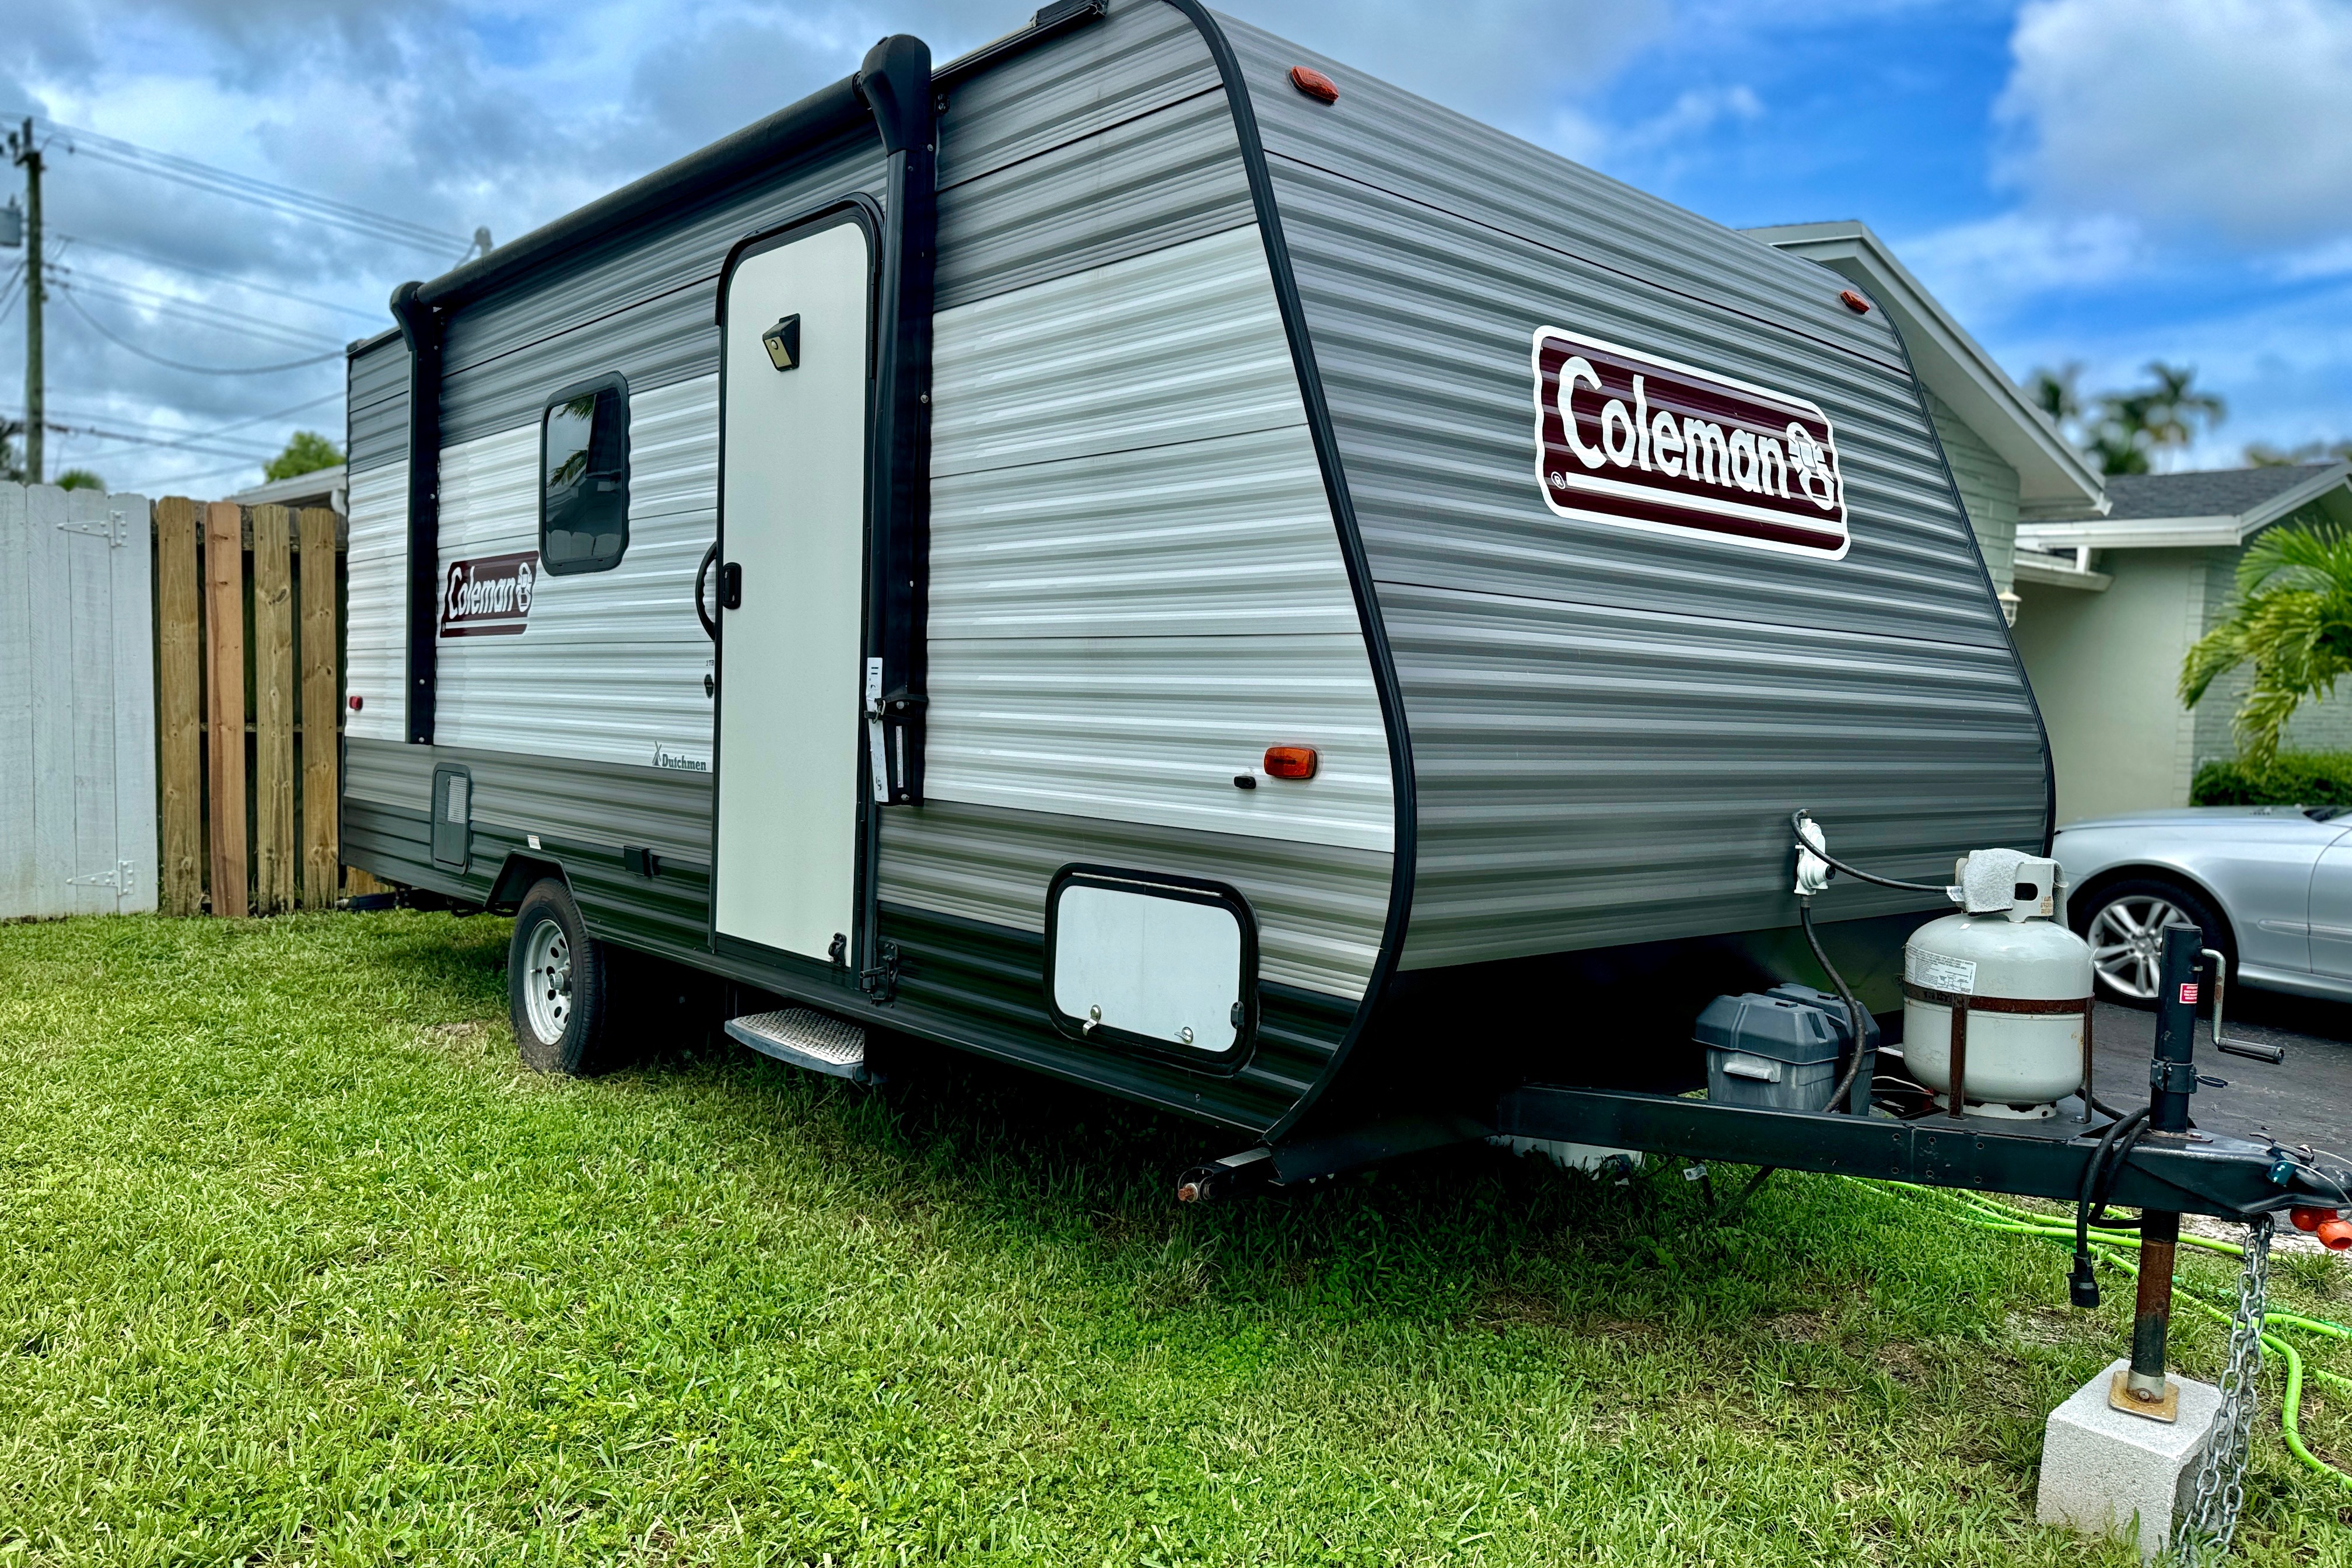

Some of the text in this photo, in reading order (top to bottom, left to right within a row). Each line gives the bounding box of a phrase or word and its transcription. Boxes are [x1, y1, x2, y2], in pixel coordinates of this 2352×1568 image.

[1557, 356, 1791, 499] Coleman
[447, 566, 516, 620] Coleman
[662, 753, 707, 771] Dutchmen
